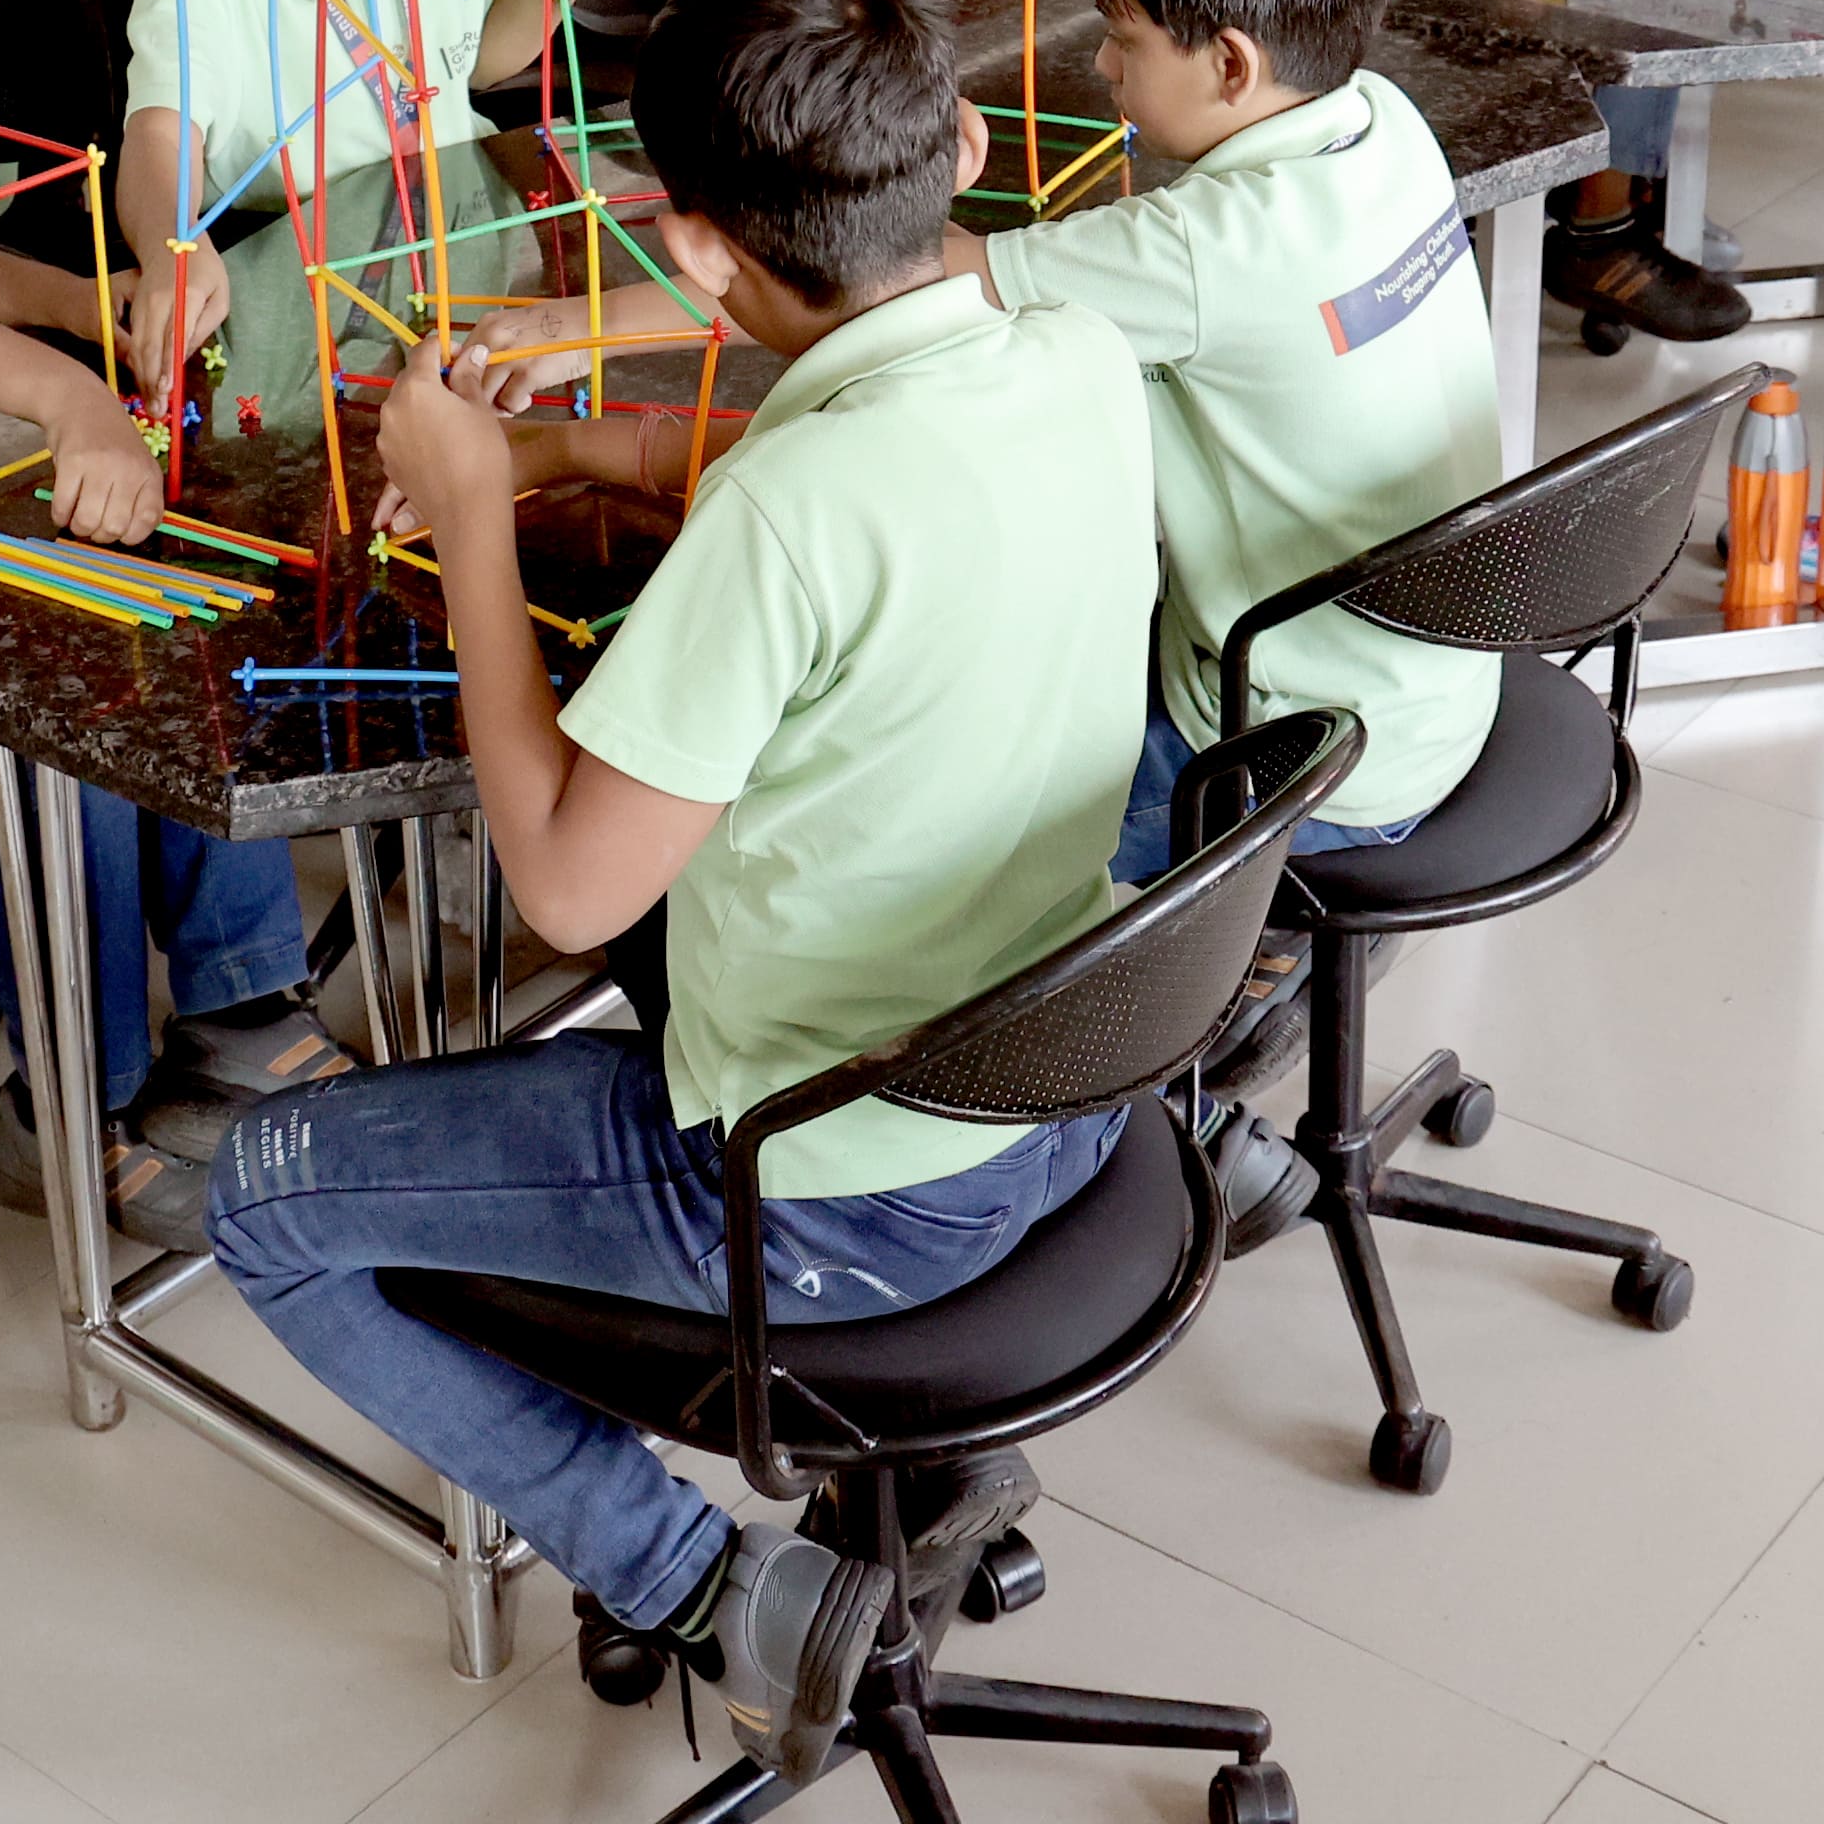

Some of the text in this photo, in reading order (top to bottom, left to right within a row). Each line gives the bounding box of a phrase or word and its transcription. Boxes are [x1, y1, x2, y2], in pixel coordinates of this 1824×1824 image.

[1373, 250, 1428, 303] Nourishing
[1401, 267, 1437, 305] Shaping
[260, 1117, 272, 1169] BEGINS
